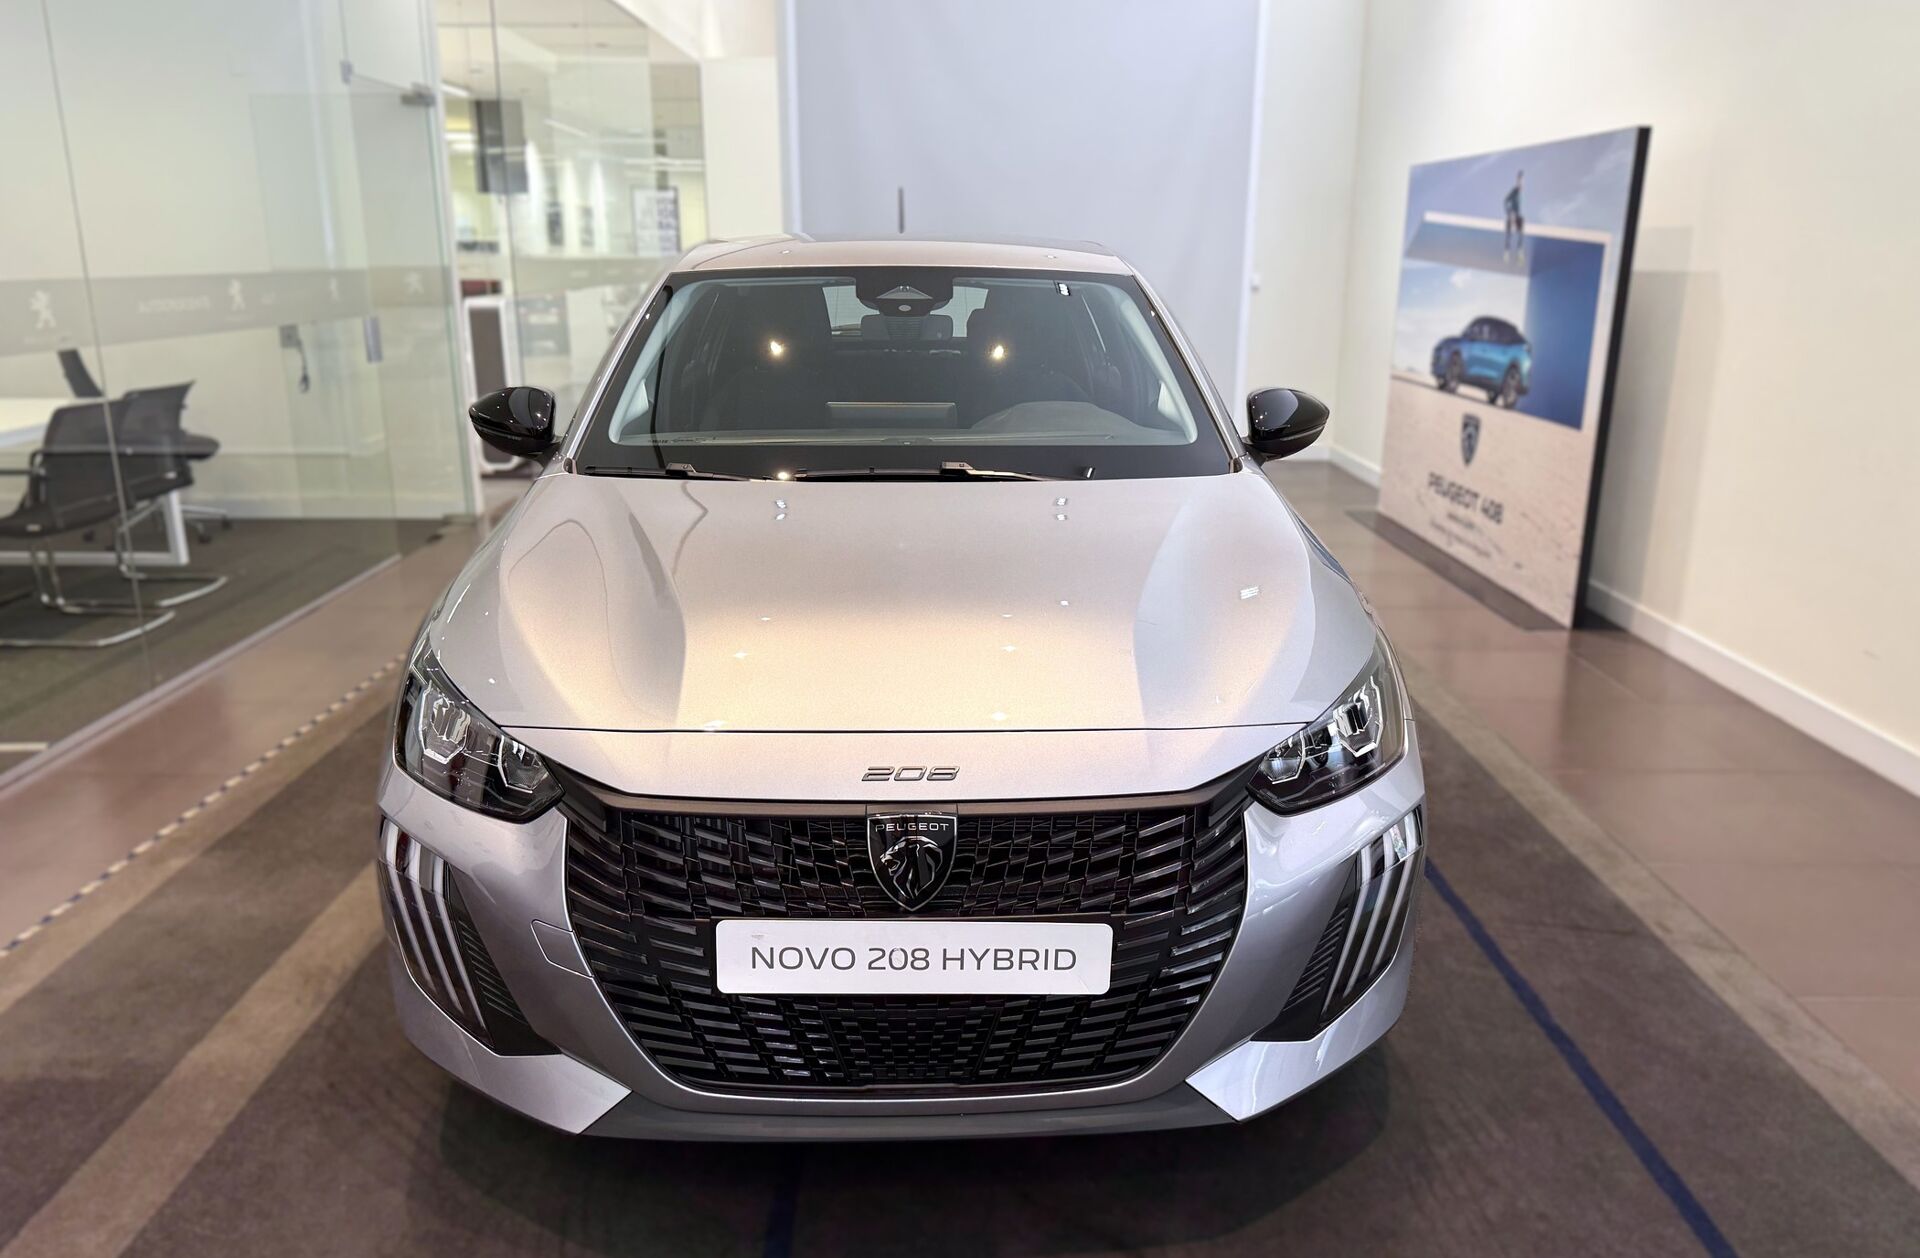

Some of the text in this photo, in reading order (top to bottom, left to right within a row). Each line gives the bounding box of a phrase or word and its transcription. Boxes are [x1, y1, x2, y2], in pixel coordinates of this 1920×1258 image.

[861, 765, 960, 782] 208
[875, 822, 950, 833] PEUGEOT
[751, 946, 1077, 971] NOVO 208 HYBRID
